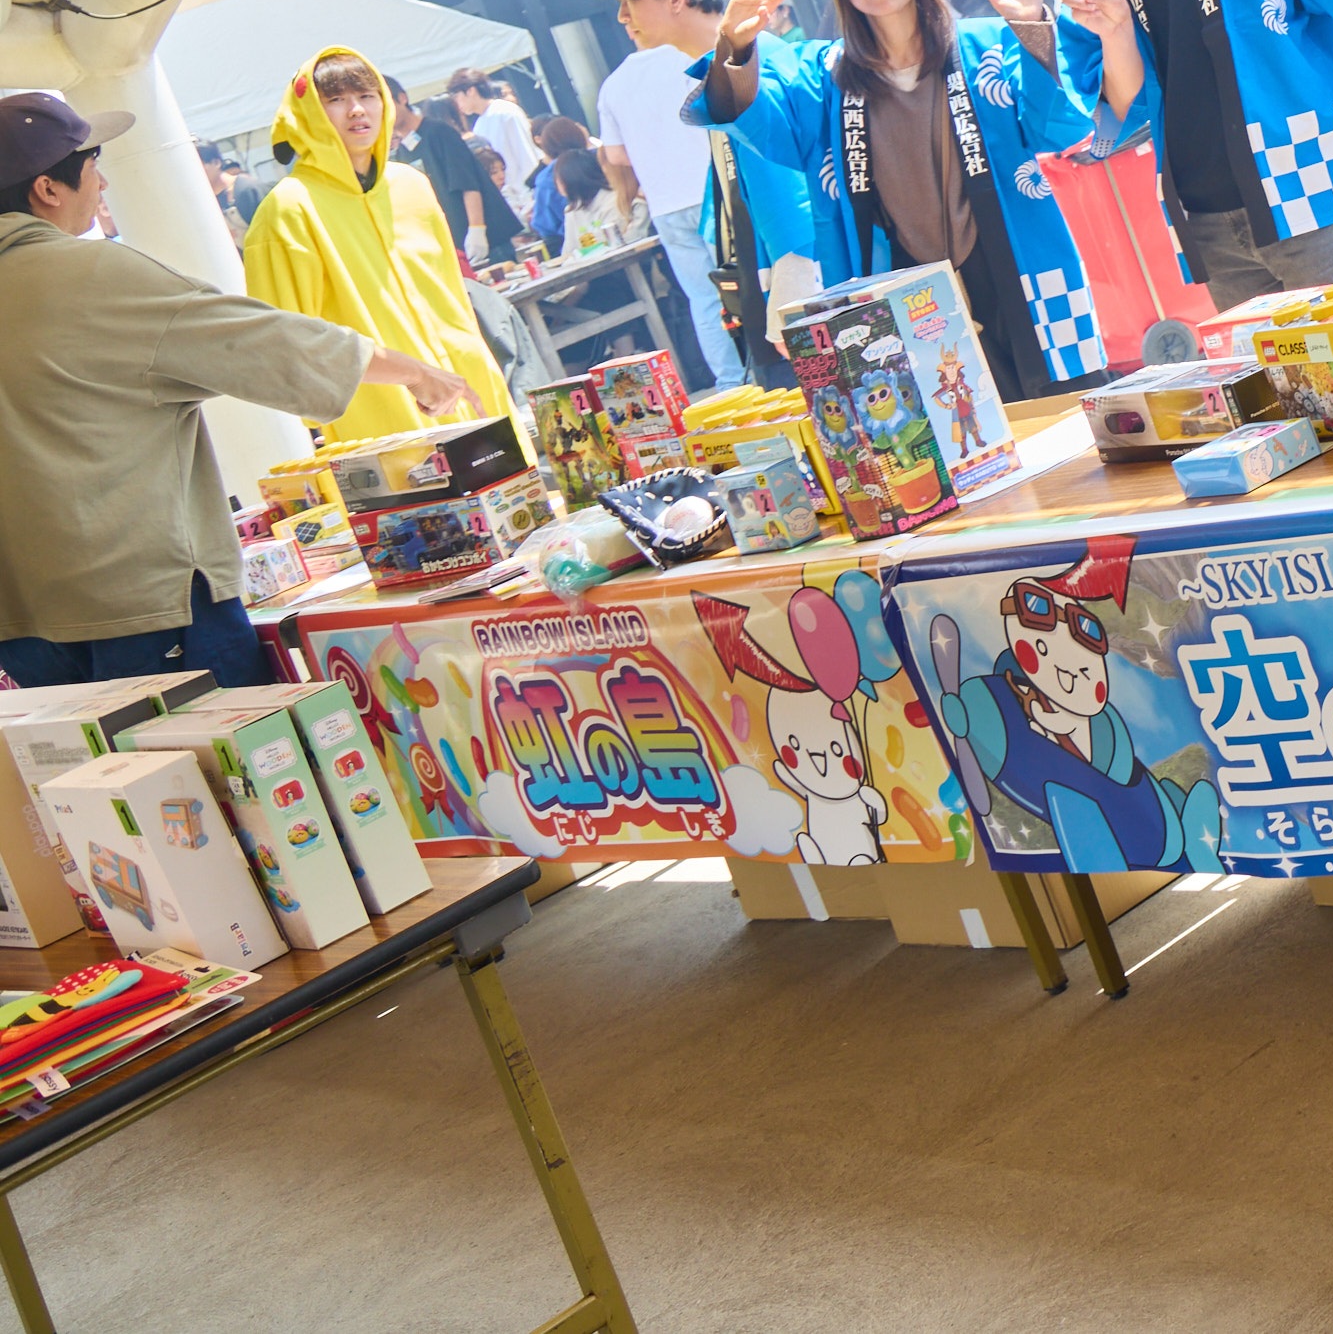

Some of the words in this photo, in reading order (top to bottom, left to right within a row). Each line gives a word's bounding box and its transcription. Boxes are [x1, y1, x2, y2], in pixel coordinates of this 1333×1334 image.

[946, 71, 989, 177] 関西広告社
[902, 286, 933, 311] TOY
[816, 330, 827, 348] 2
[1278, 341, 1308, 357] CLASS
[576, 394, 585, 409] 2
[648, 389, 657, 405] 2
[1208, 393, 1220, 413] 2
[437, 457, 446, 473] 2
[760, 494, 771, 512] 2
[250, 521, 260, 536] 2
[475, 516, 484, 532] 2
[476, 620, 566, 658] RAINBOW
[570, 610, 648, 650] ISLAND
[319, 723, 352, 740] WOODEN
[495, 665, 720, 808] 虹の島
[89, 729, 102, 754] 1
[222, 745, 237, 772] 1
[258, 751, 292, 769] WOODEN
[120, 804, 135, 831] 1
[553, 814, 597, 844] にじ
[677, 808, 727, 840] しま
